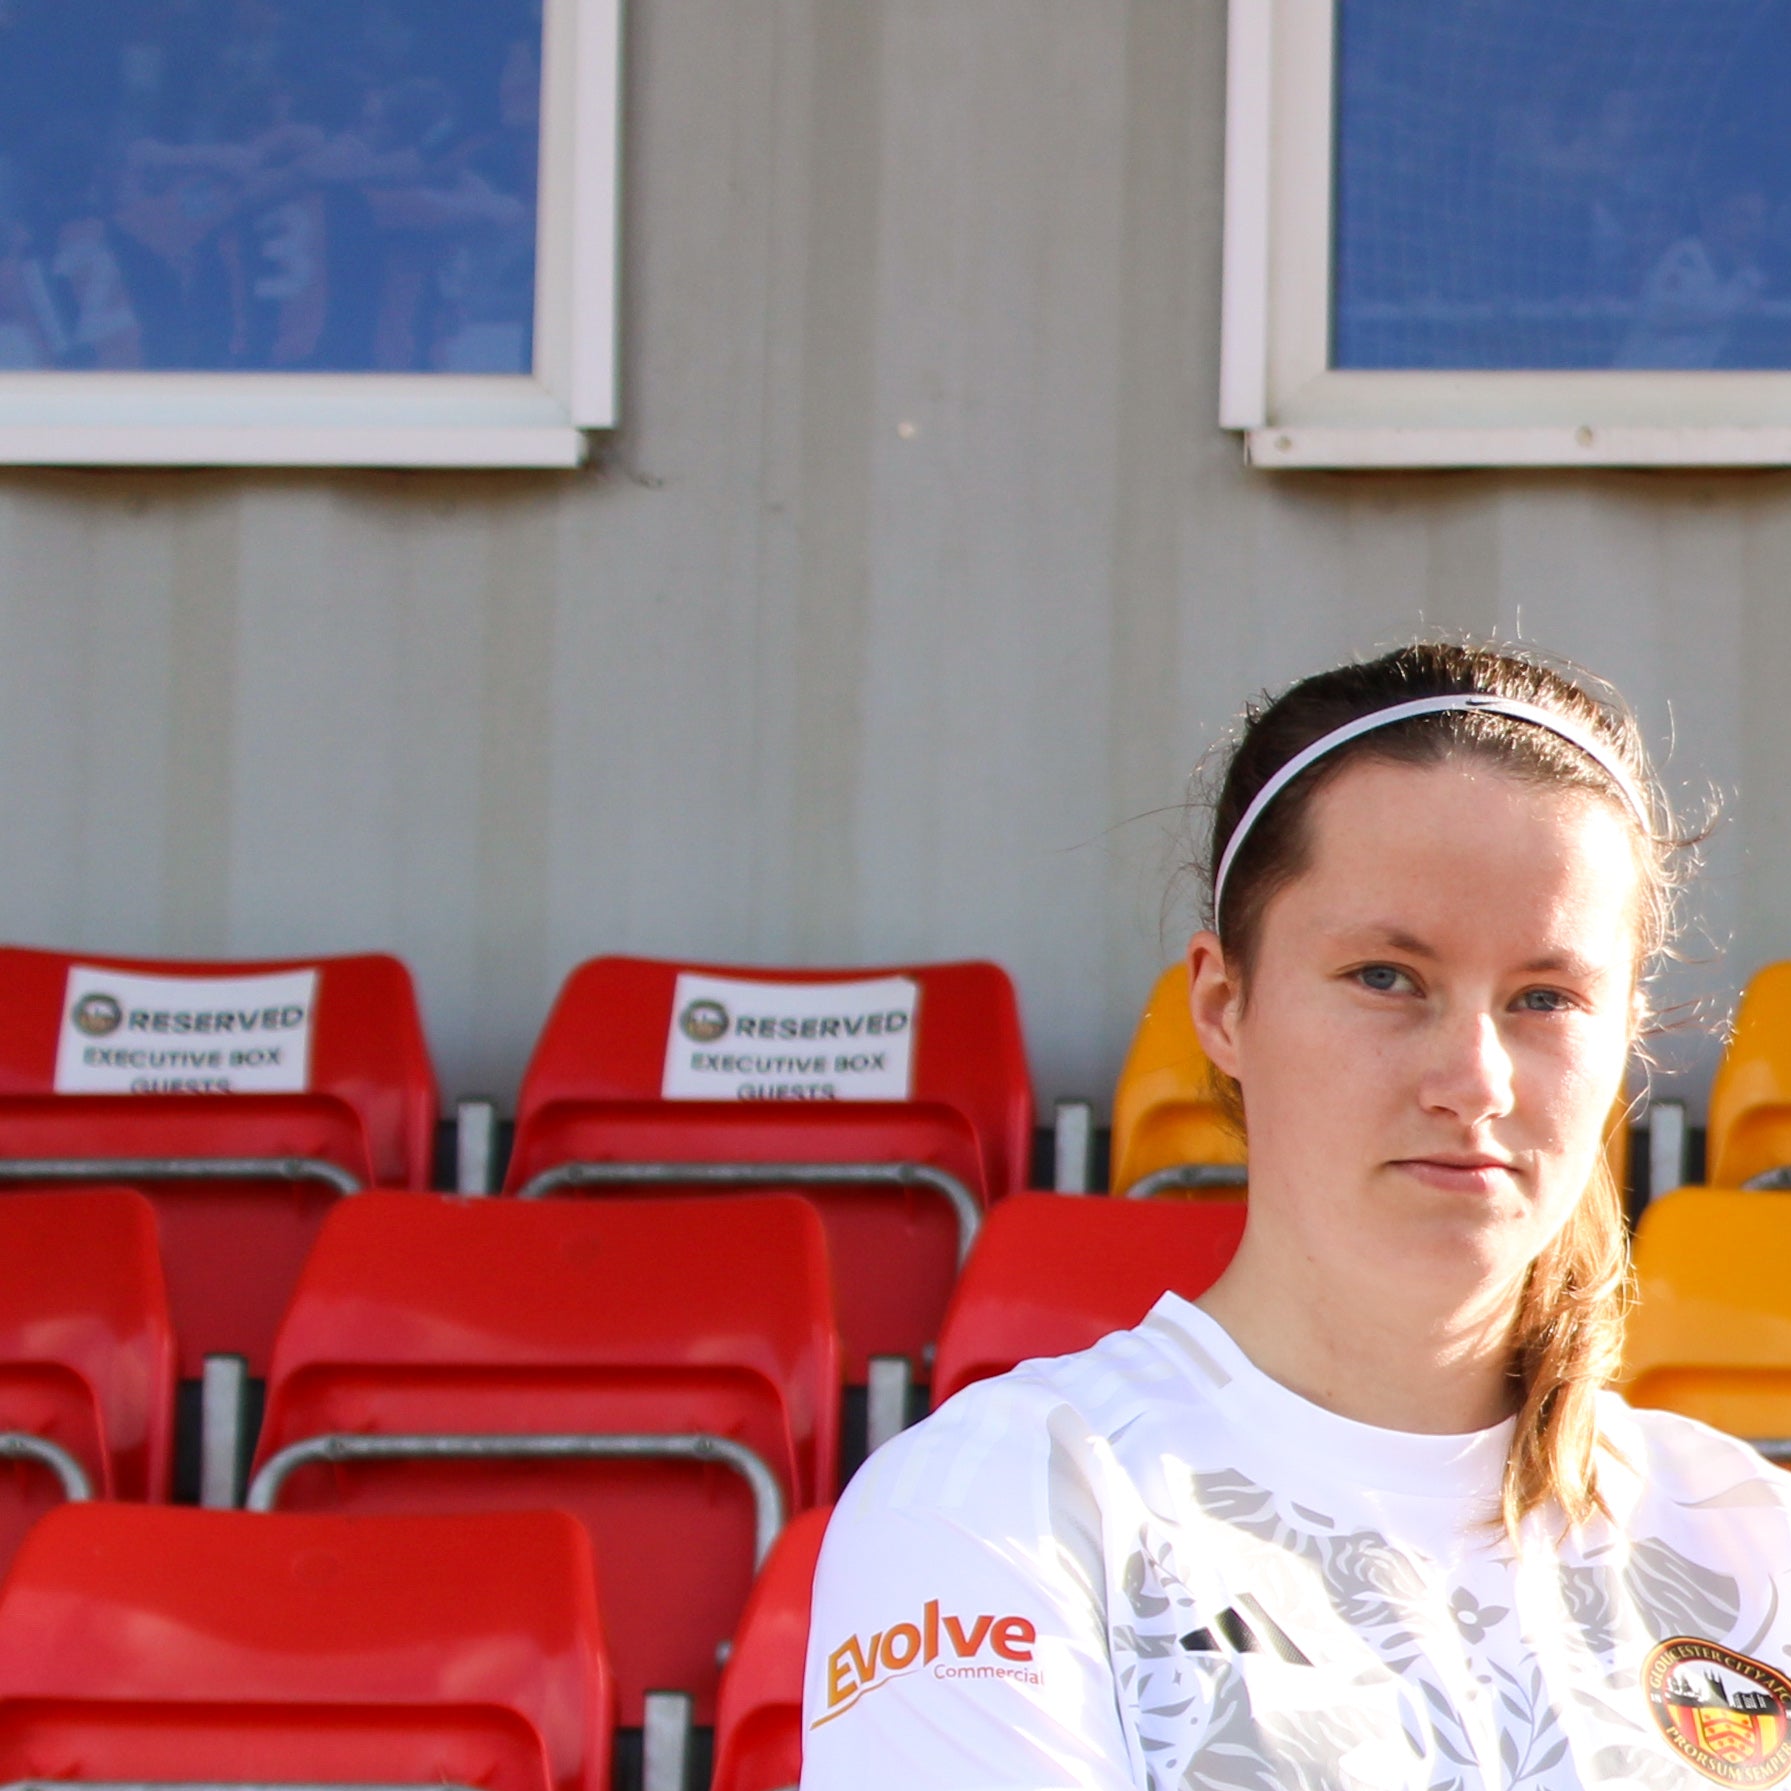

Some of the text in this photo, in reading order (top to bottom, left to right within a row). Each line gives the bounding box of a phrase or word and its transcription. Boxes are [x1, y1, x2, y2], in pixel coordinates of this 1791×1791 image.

[129, 1006, 304, 1033] RESERVED
[735, 1011, 908, 1039] RESERVED
[82, 1047, 281, 1068] EXECUTIVE BOX
[690, 1052, 886, 1073] EXECUTIVE BOX
[826, 1598, 1037, 1711] Evolve
[1649, 1644, 1723, 1690] GLOUCESTER
[1724, 1656, 1766, 1681] CITY
[933, 1663, 1046, 1686] Commercial
[1665, 1725, 1744, 1782] PRORSUM
